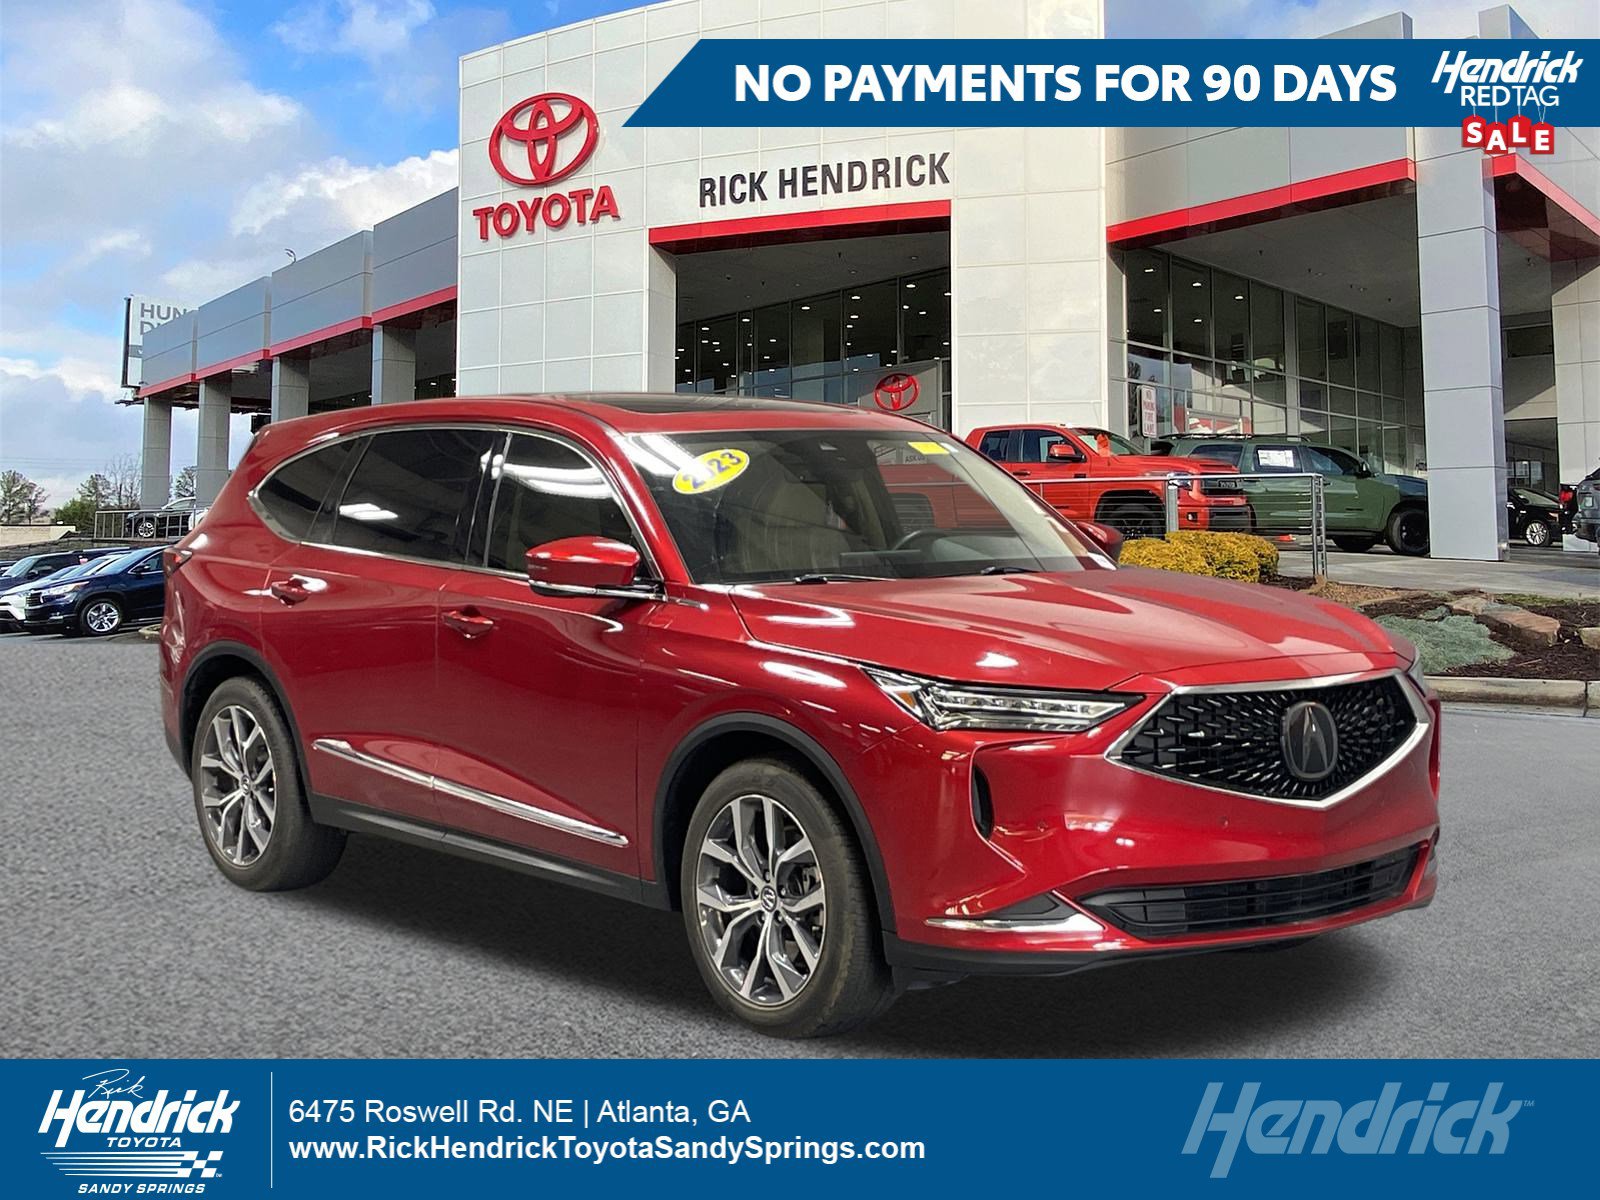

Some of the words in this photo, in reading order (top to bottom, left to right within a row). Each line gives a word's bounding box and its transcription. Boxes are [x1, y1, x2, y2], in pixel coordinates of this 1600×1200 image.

[699, 170, 768, 208] RICK
[778, 151, 950, 200] HENDRICK
[472, 185, 621, 241] TOYOTA
